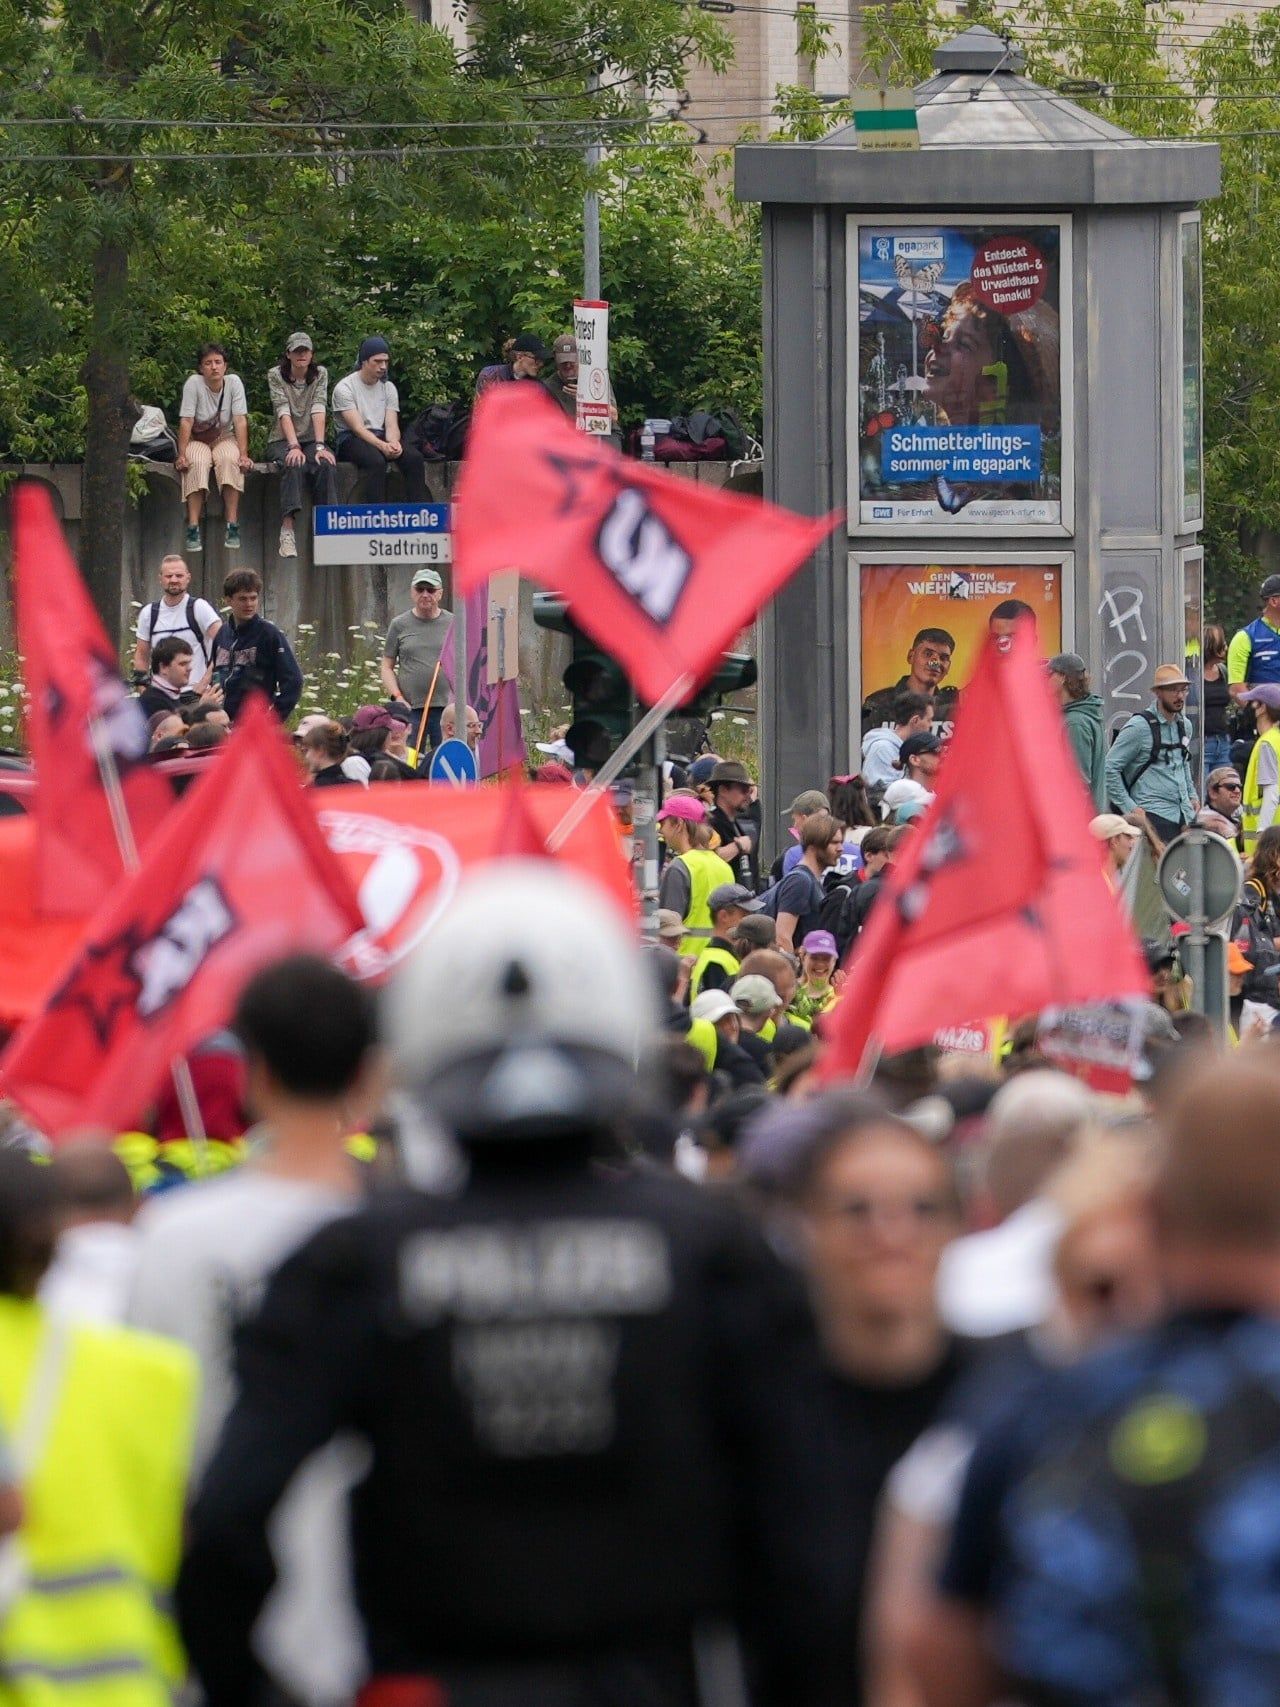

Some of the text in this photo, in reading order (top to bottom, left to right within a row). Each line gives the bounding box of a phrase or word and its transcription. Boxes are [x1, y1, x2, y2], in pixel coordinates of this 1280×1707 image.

[898, 241, 939, 253] egapark
[984, 247, 1028, 262] Entdeckt
[973, 266, 991, 278] das
[981, 275, 1040, 291] Urwaldhaus
[992, 288, 1032, 305] Danakil!
[891, 432, 1031, 456] Schmetterlings-
[890, 455, 1031, 475] sommer im egapark
[327, 508, 439, 530] Heinrichstraße
[911, 508, 933, 517] Erfurt
[369, 539, 439, 560] Stadtring
[930, 573, 995, 581] GENTION
[907, 581, 1017, 594] WEHIENST
